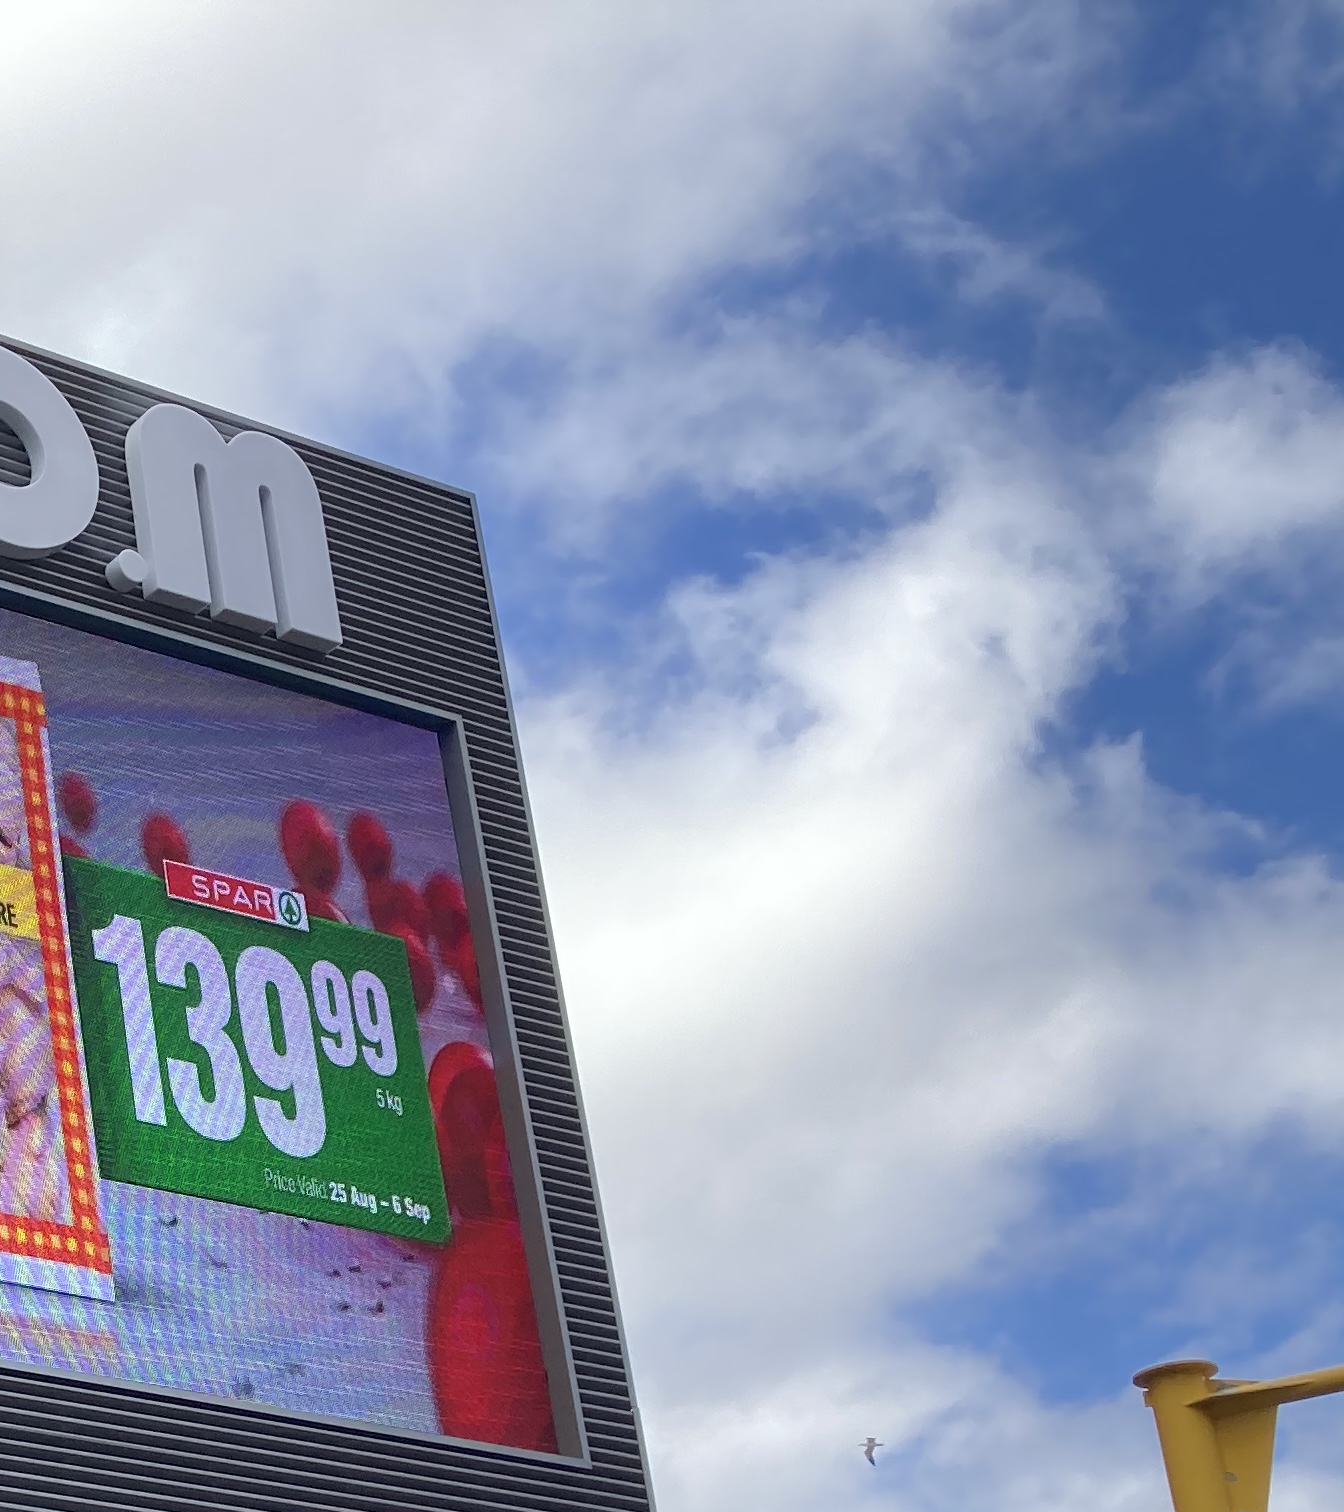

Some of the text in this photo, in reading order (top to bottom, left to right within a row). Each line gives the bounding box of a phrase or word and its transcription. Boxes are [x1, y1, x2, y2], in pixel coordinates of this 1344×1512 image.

[191, 875, 272, 912] SPAR
[376, 1088, 403, 1117] 5 kg
[264, 1168, 297, 1193] Price
[329, 1181, 347, 1203] 25
[350, 1185, 378, 1214] Aug
[391, 1195, 402, 1214] 6
[404, 1197, 431, 1225] Sep
